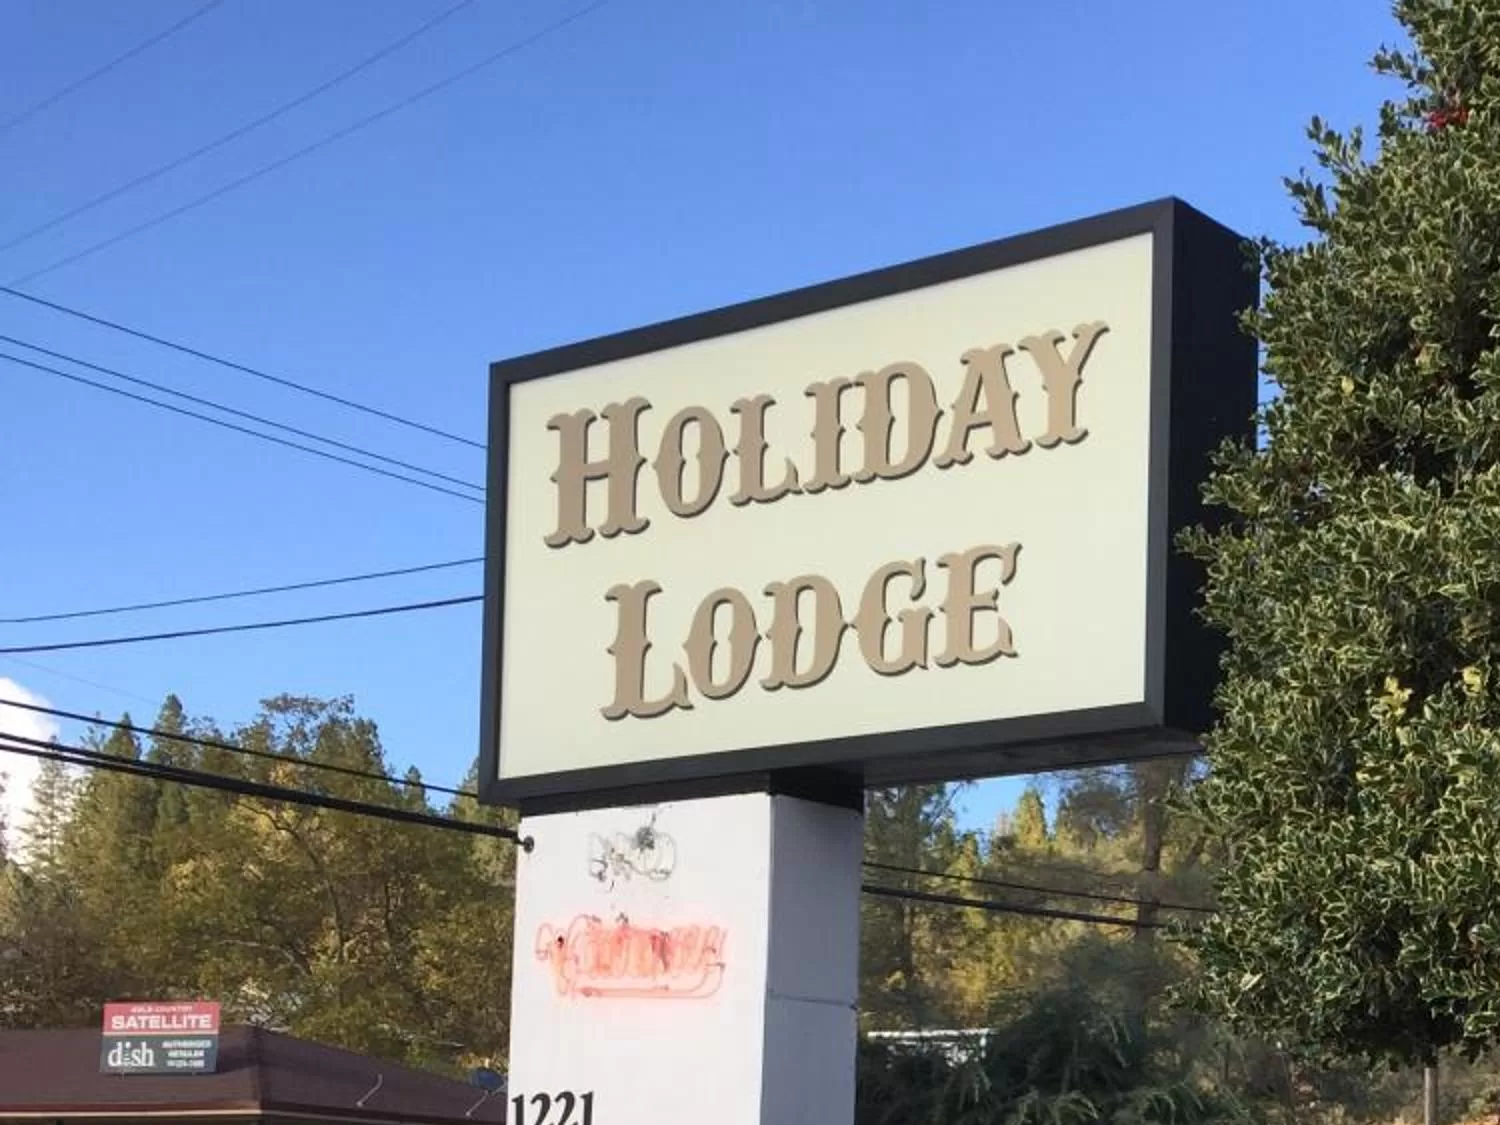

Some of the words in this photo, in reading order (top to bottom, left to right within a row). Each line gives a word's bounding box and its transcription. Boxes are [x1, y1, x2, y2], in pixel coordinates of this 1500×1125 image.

[544, 320, 1109, 548] HOLIDAY
[600, 541, 1022, 721] LODGE
[107, 1041, 155, 1068] dish
[111, 1013, 213, 1030] SATELLITE
